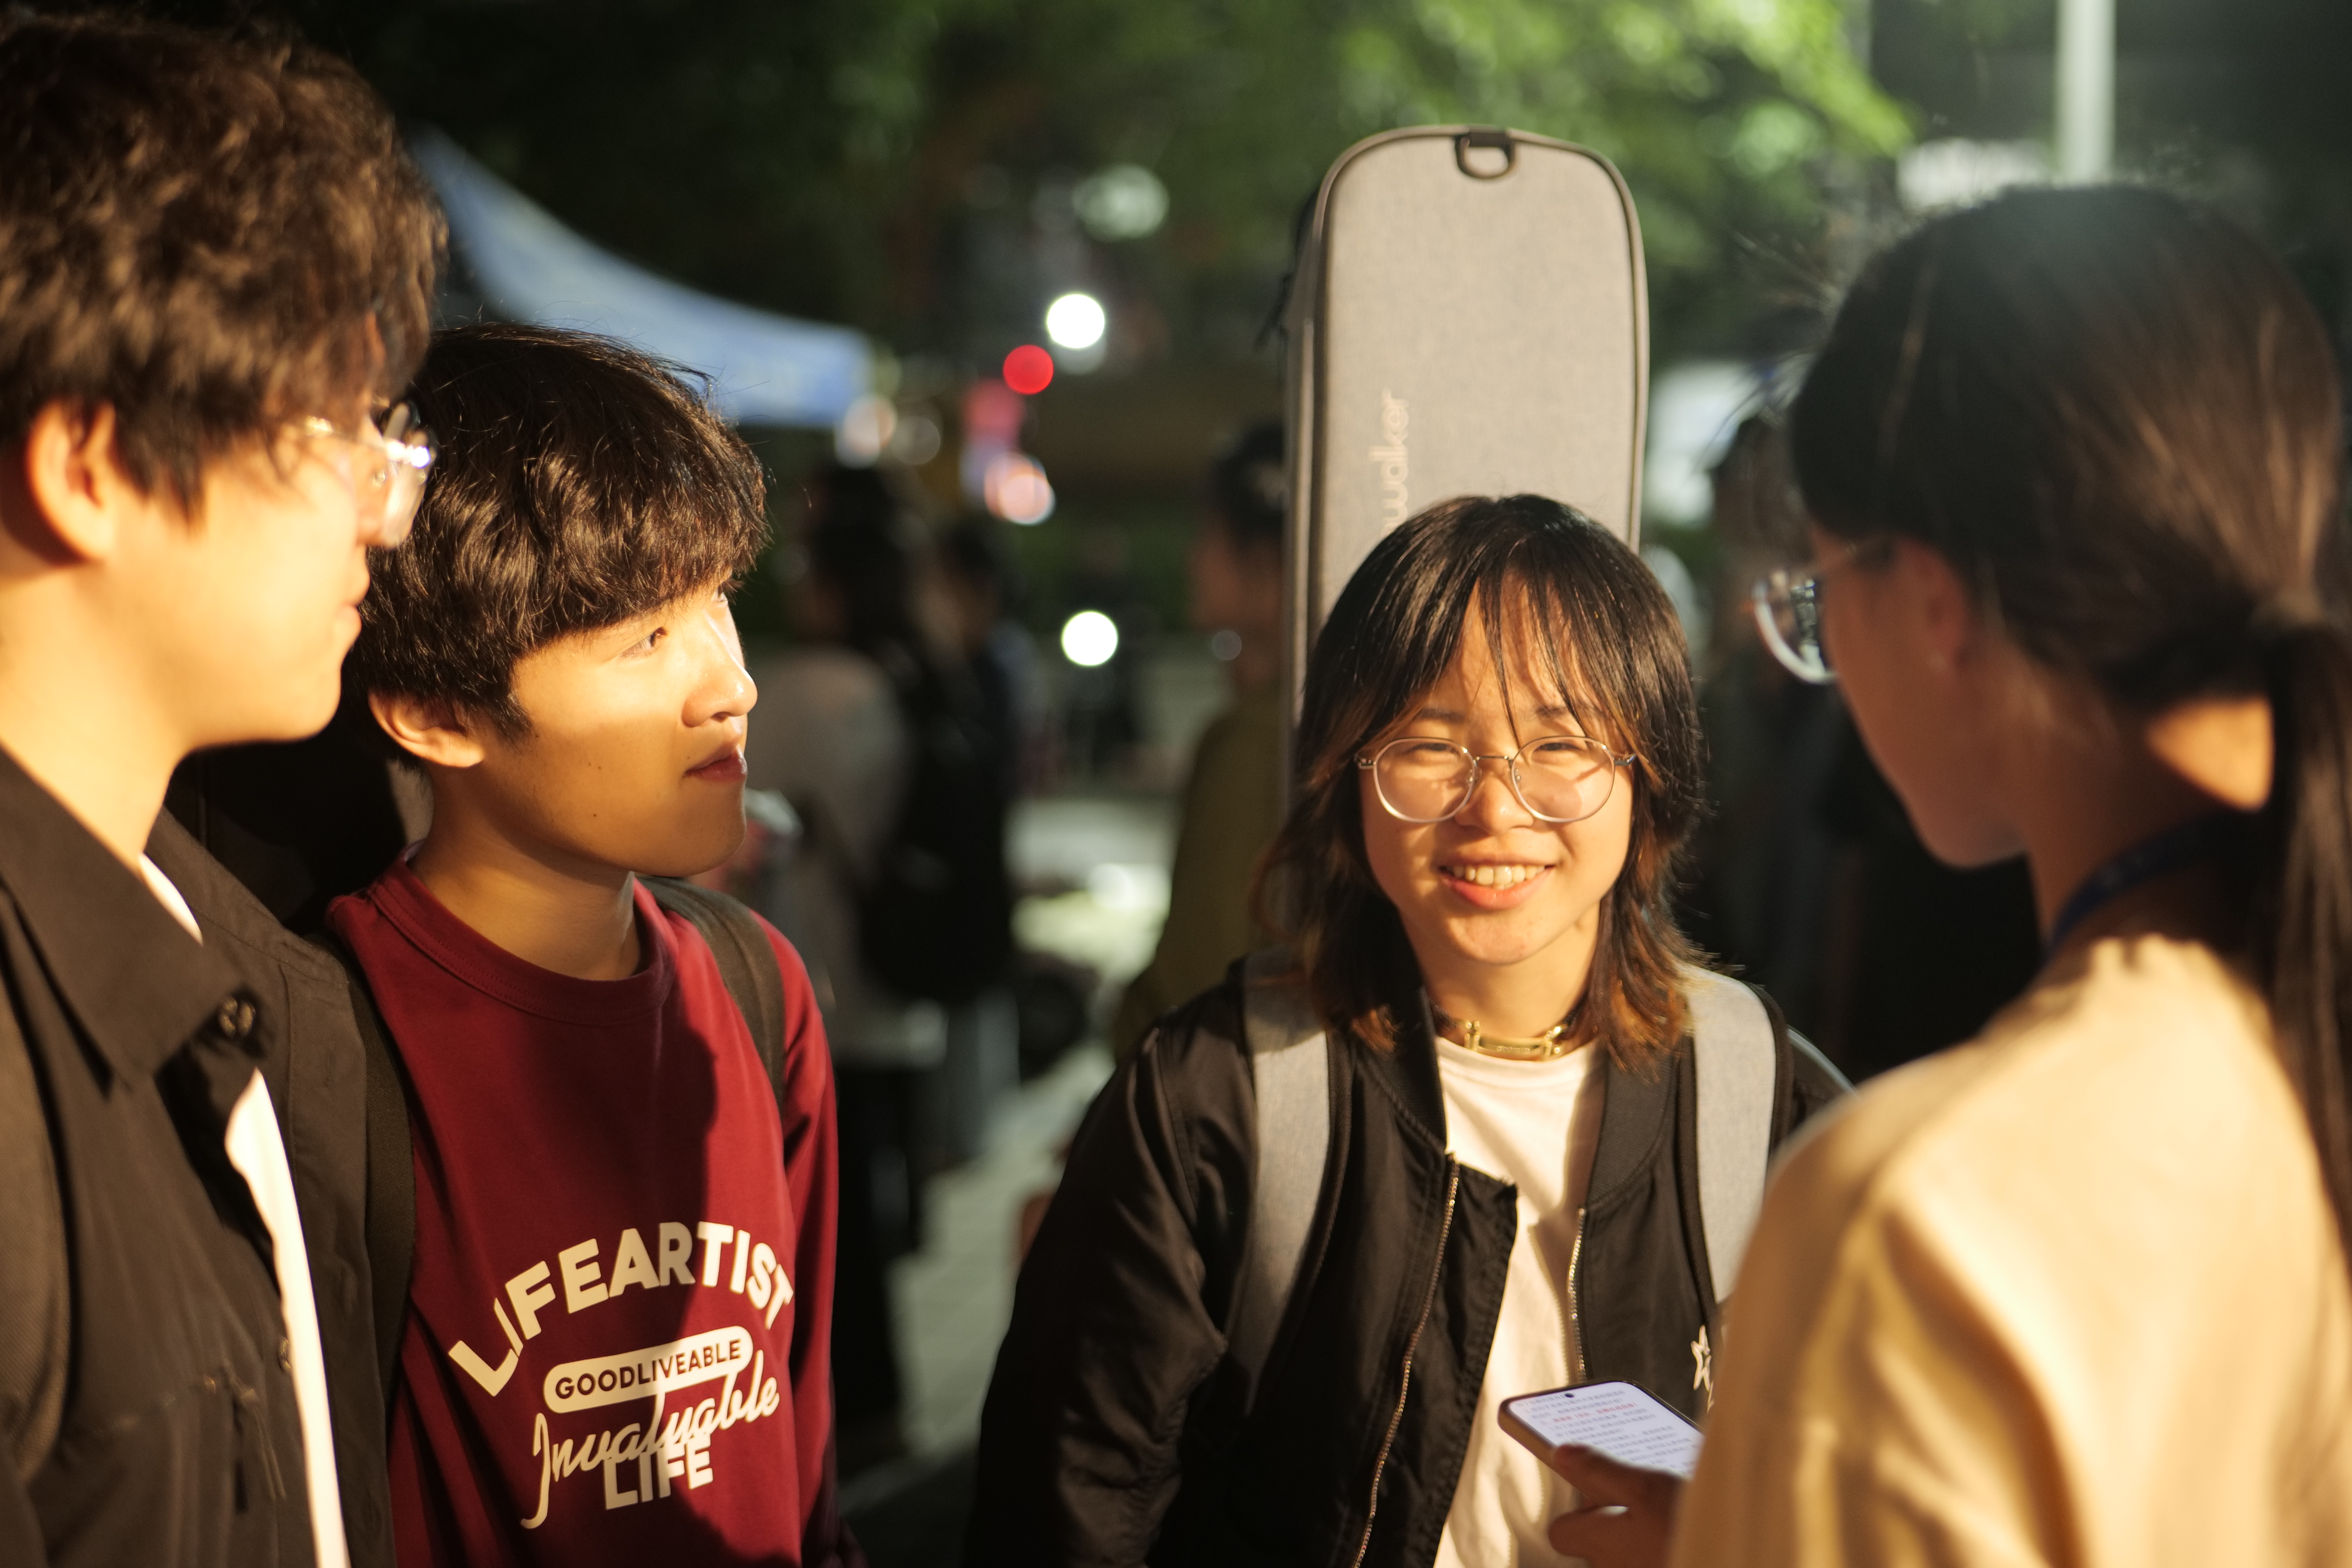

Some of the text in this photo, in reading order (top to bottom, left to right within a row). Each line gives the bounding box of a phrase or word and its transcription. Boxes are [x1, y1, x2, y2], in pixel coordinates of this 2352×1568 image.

[555, 1339, 742, 1400] GOODLIVEABLE
[520, 1349, 780, 1529] Invaluable
[604, 1434, 713, 1510] LIFE
